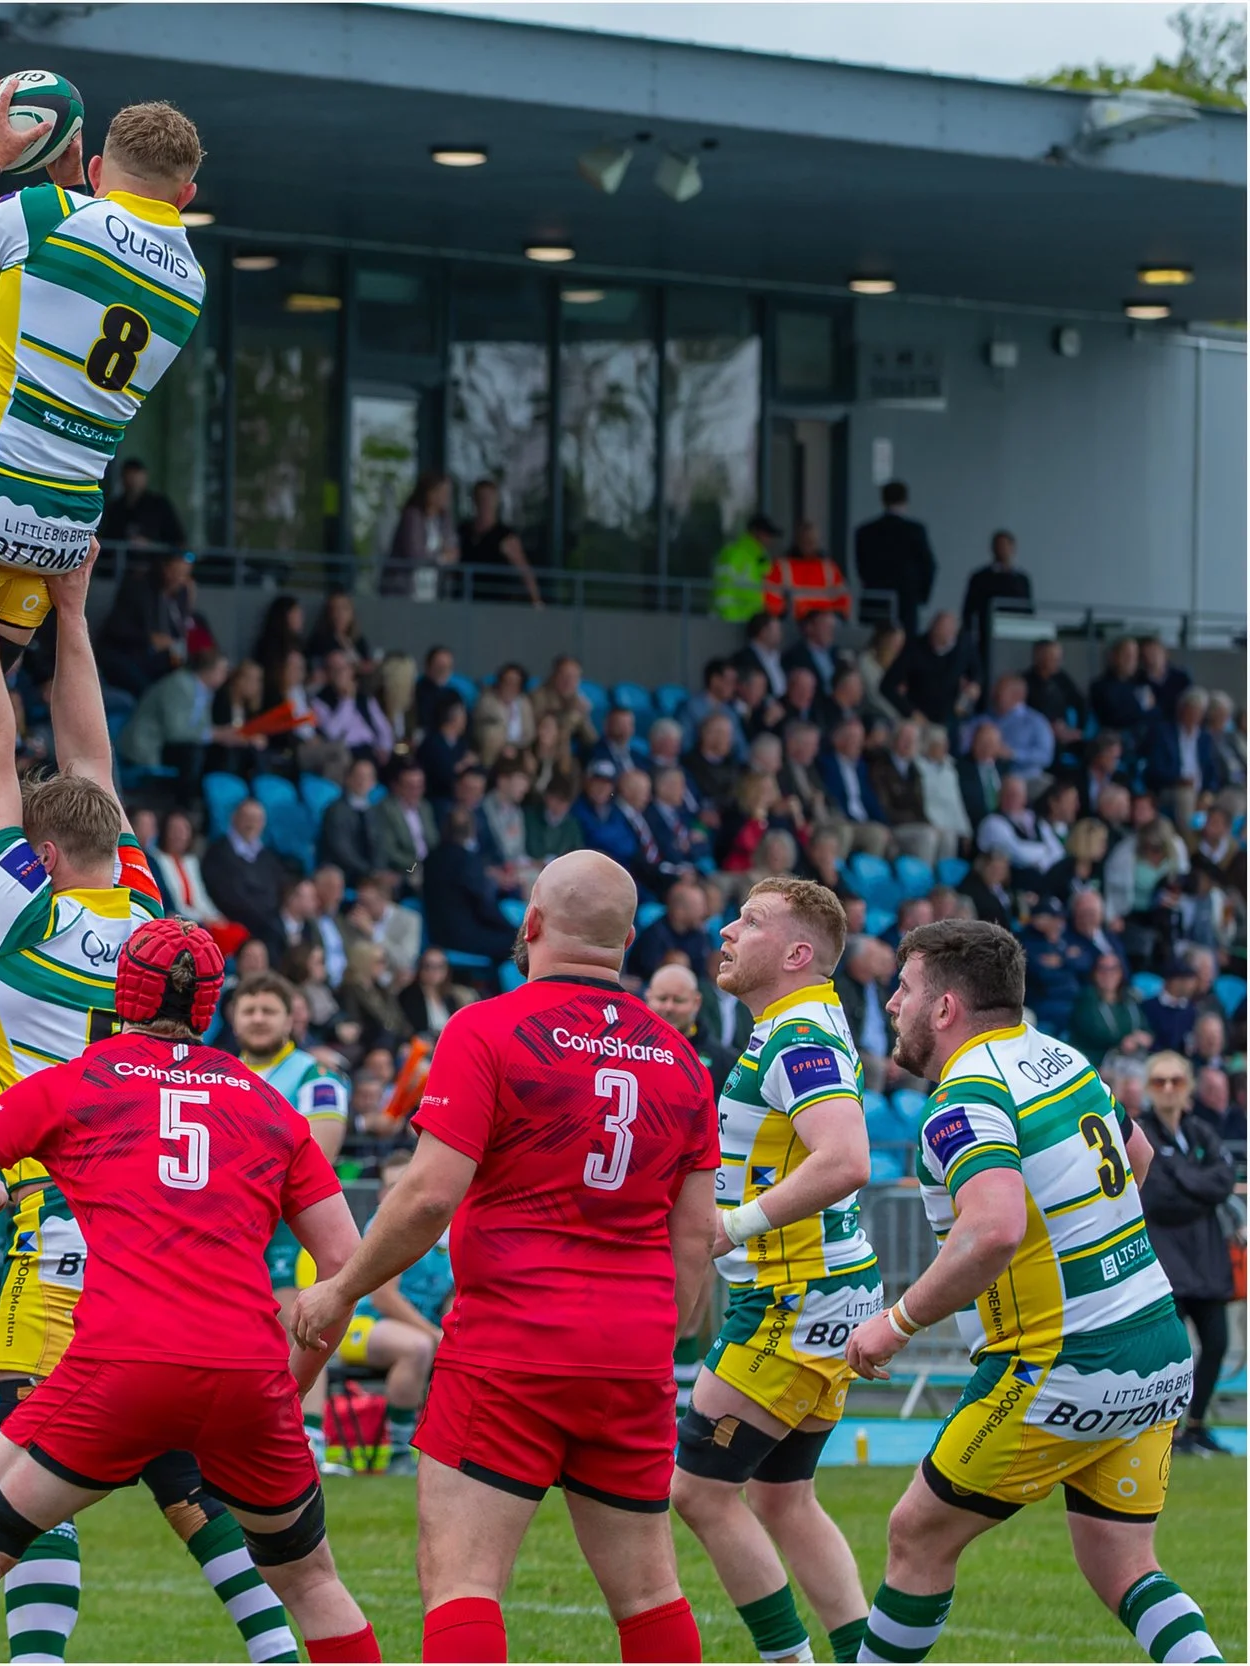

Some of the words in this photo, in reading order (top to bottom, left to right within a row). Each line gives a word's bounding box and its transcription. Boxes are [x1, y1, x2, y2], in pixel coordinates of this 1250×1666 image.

[105, 214, 189, 280] Qualis
[84, 303, 151, 393] 8
[113, 1061, 251, 1092] CoinShares
[551, 1027, 675, 1066] CoinShares
[792, 1057, 831, 1074] SPRING
[1017, 1045, 1074, 1088] Qualis
[158, 1087, 210, 1191] 5
[582, 1067, 639, 1191] 3
[931, 1120, 962, 1146] SPRING
[1078, 1111, 1127, 1201] 3
[959, 1379, 1028, 1465] MOOREMentum
